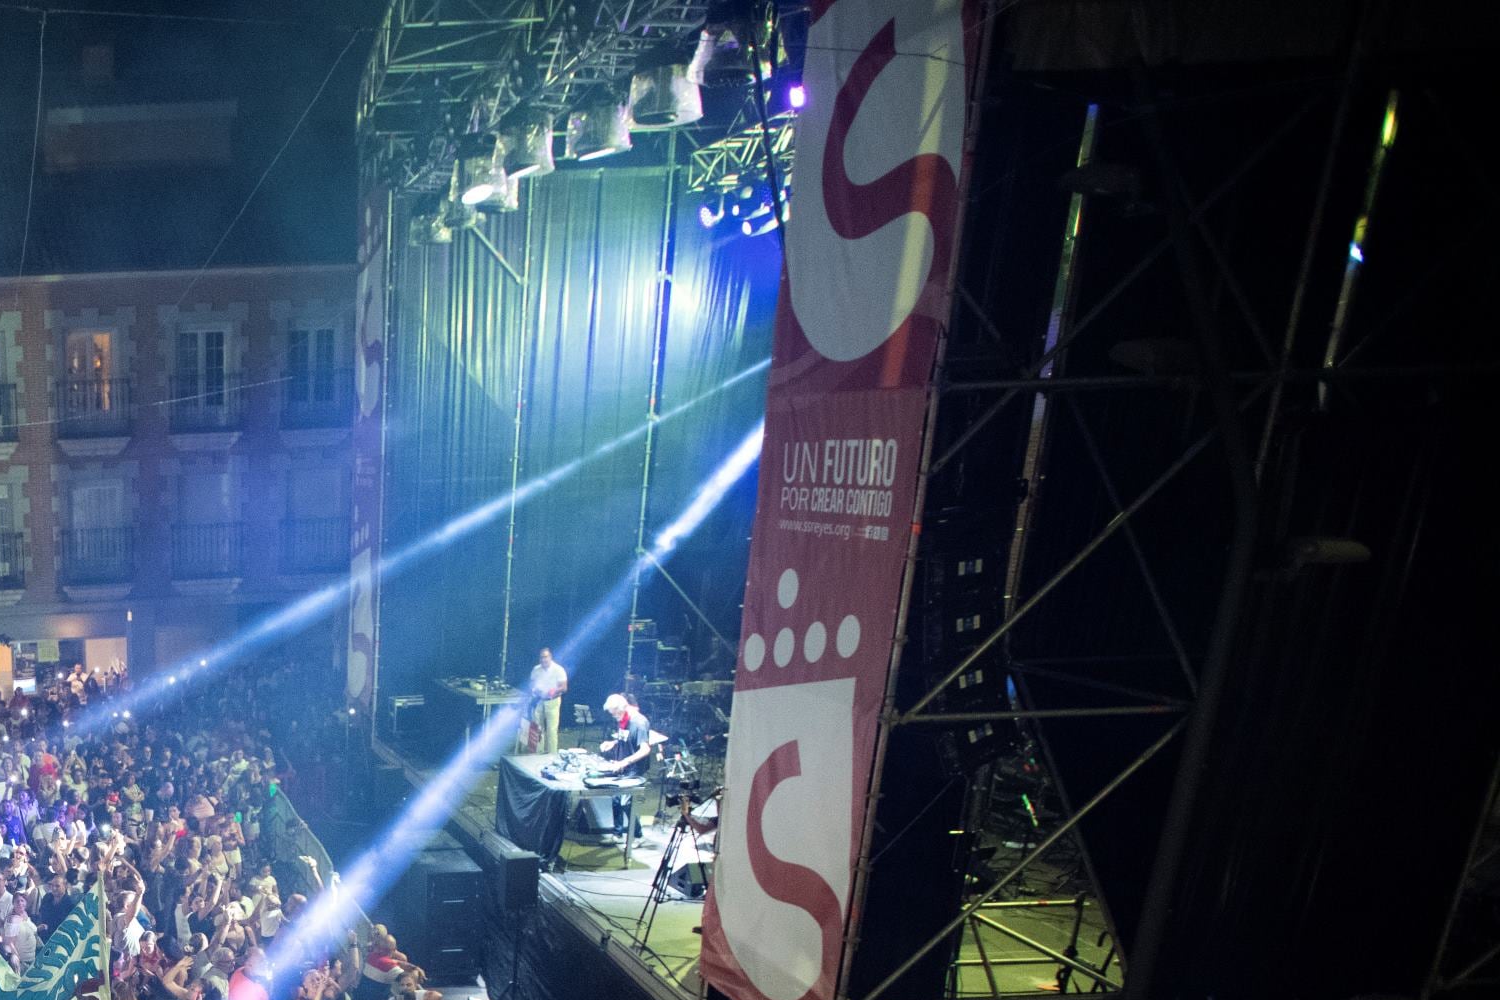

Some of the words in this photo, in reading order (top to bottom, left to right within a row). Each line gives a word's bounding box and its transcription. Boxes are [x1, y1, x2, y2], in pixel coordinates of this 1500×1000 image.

[783, 441, 819, 484] UN
[822, 438, 898, 487] FUTURO
[780, 486, 810, 511] POR
[811, 487, 845, 514] CREAR
[846, 488, 893, 517] CONTIGO
[779, 519, 851, 540] www.ssreyes.org
